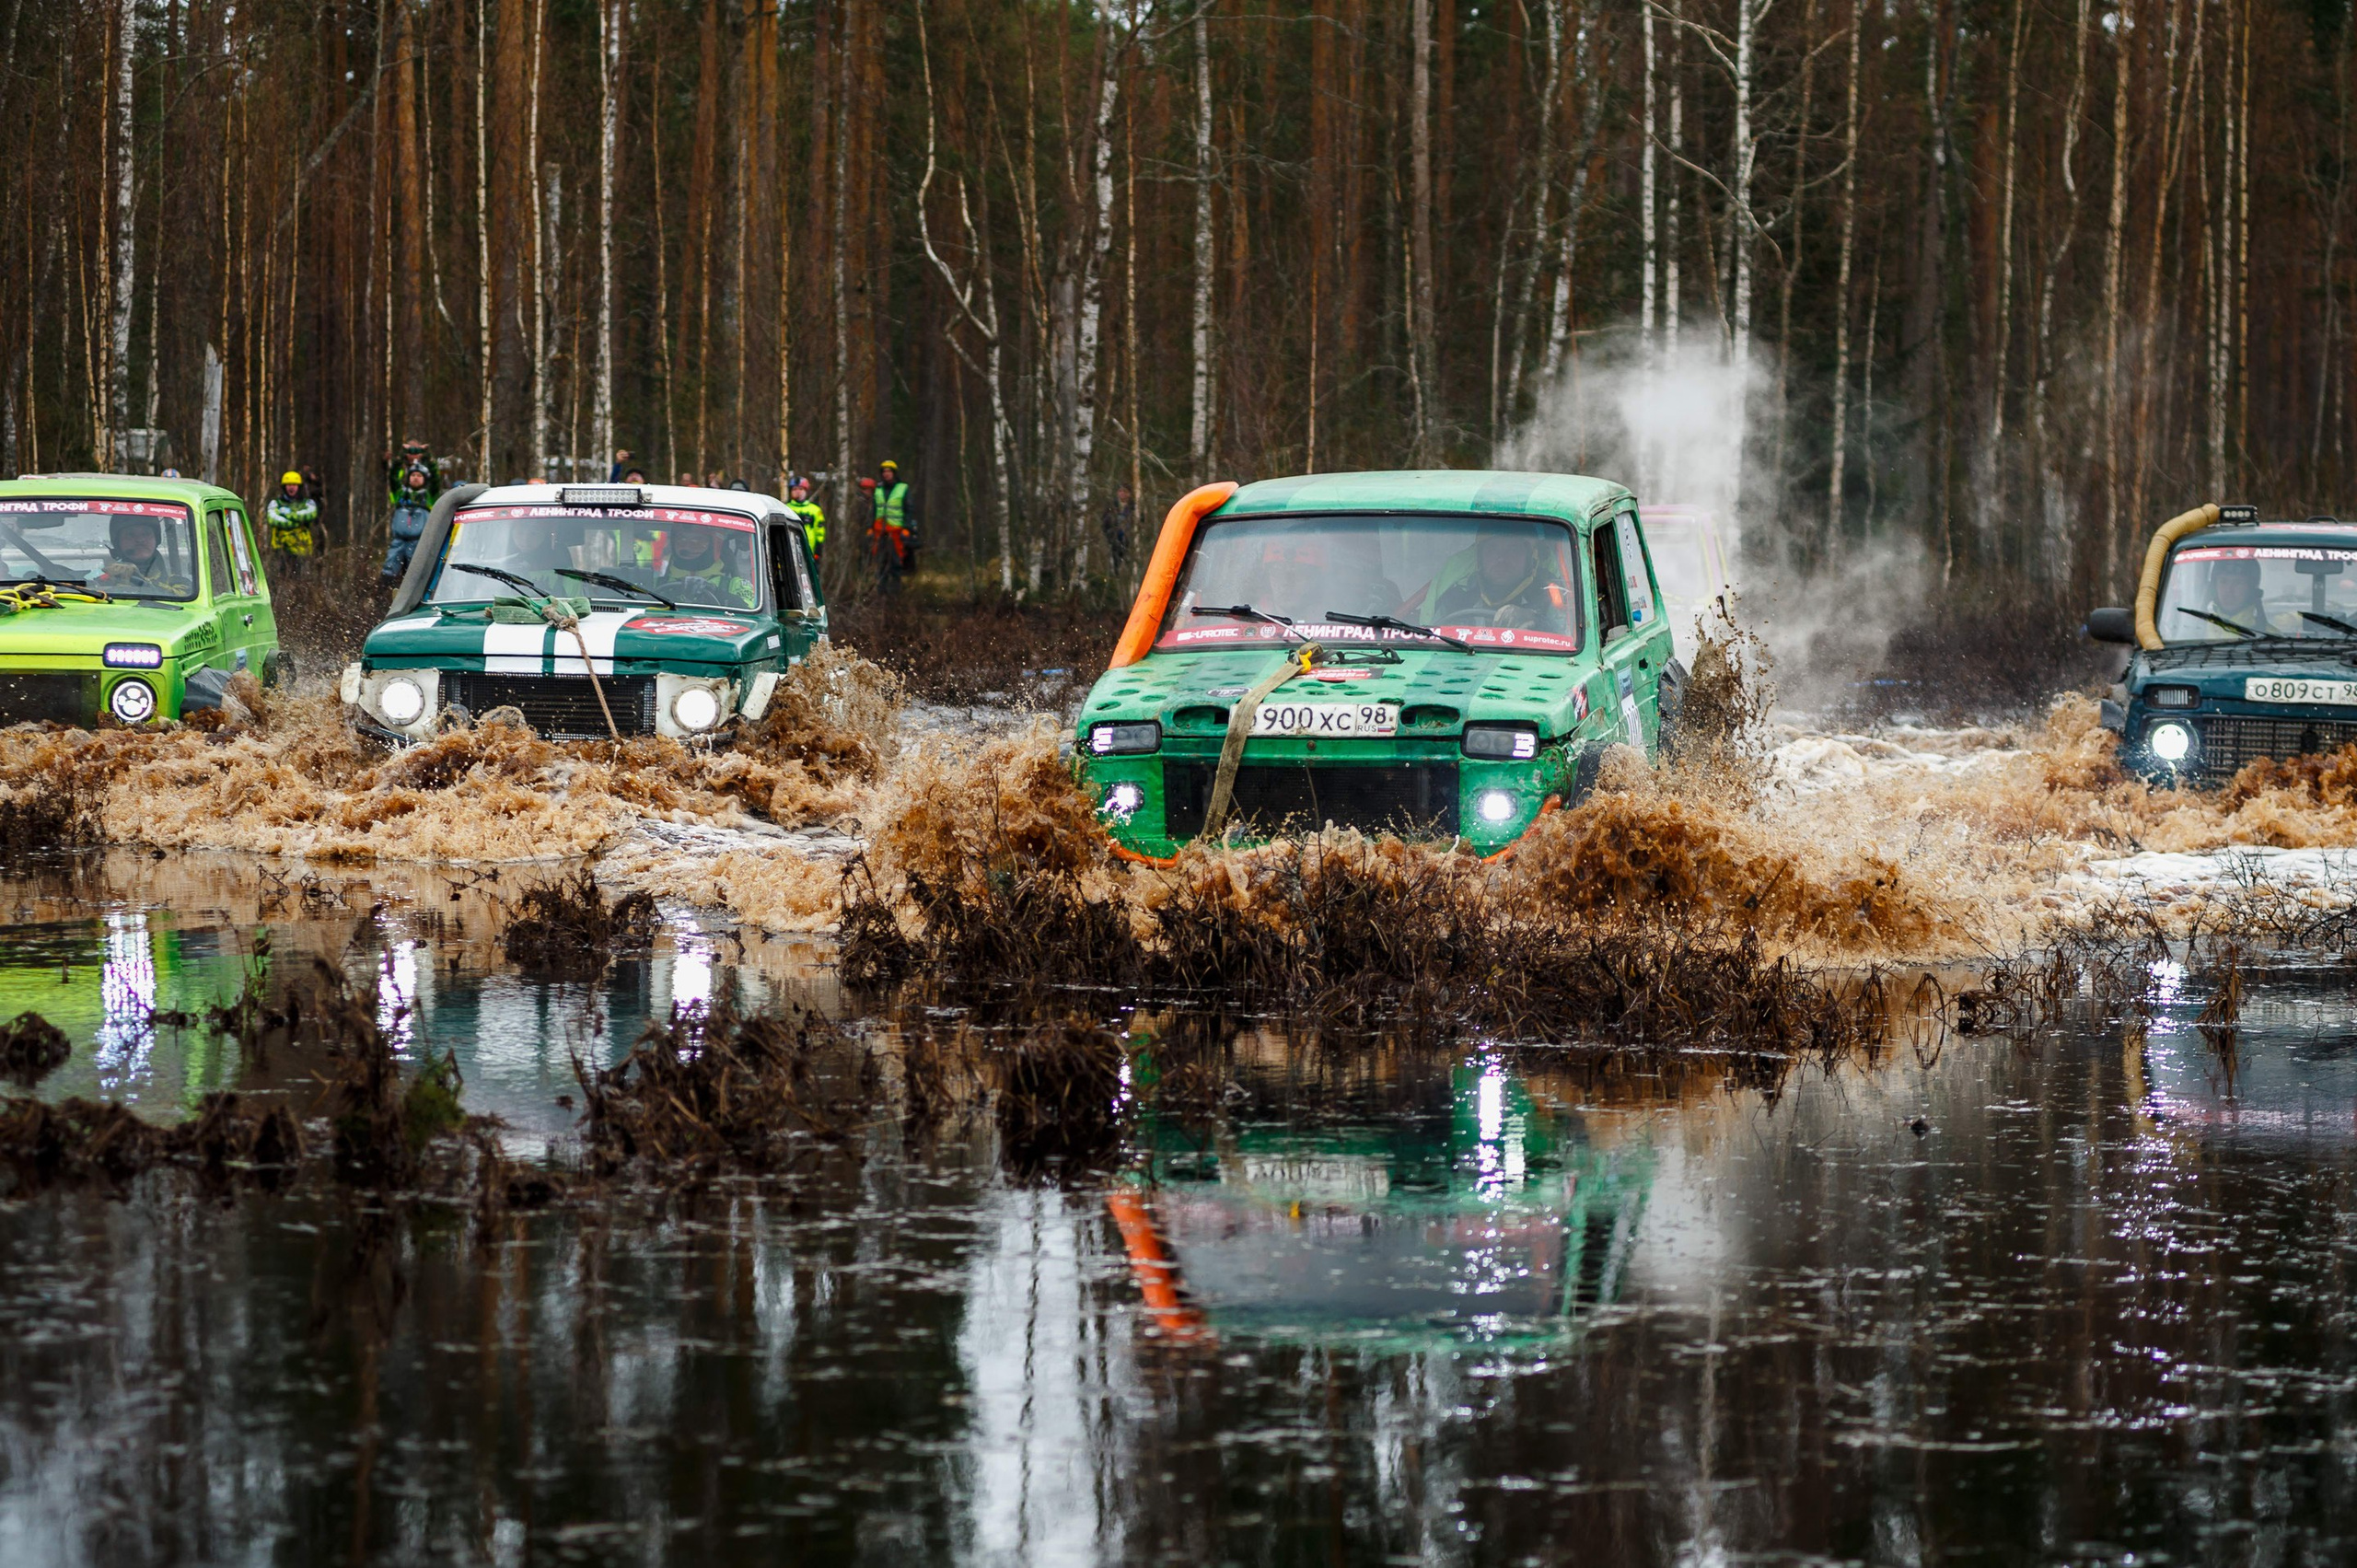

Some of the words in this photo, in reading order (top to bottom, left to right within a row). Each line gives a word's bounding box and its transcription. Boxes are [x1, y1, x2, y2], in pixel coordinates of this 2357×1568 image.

[42, 502, 88, 512] ТРОФИ
[528, 507, 603, 518] ЛЕНИНГРАД
[607, 508, 655, 518] ТРОФИ
[2253, 548, 2324, 560] ЛЕНИНГРАД
[1190, 628, 1239, 639] SUPROTEC
[1283, 625, 1376, 641] ЛЕНИНГРАД
[1523, 634, 1571, 647] suprotec.ru
[1360, 706, 1387, 725] 98
[1357, 725, 1377, 733] RUS
